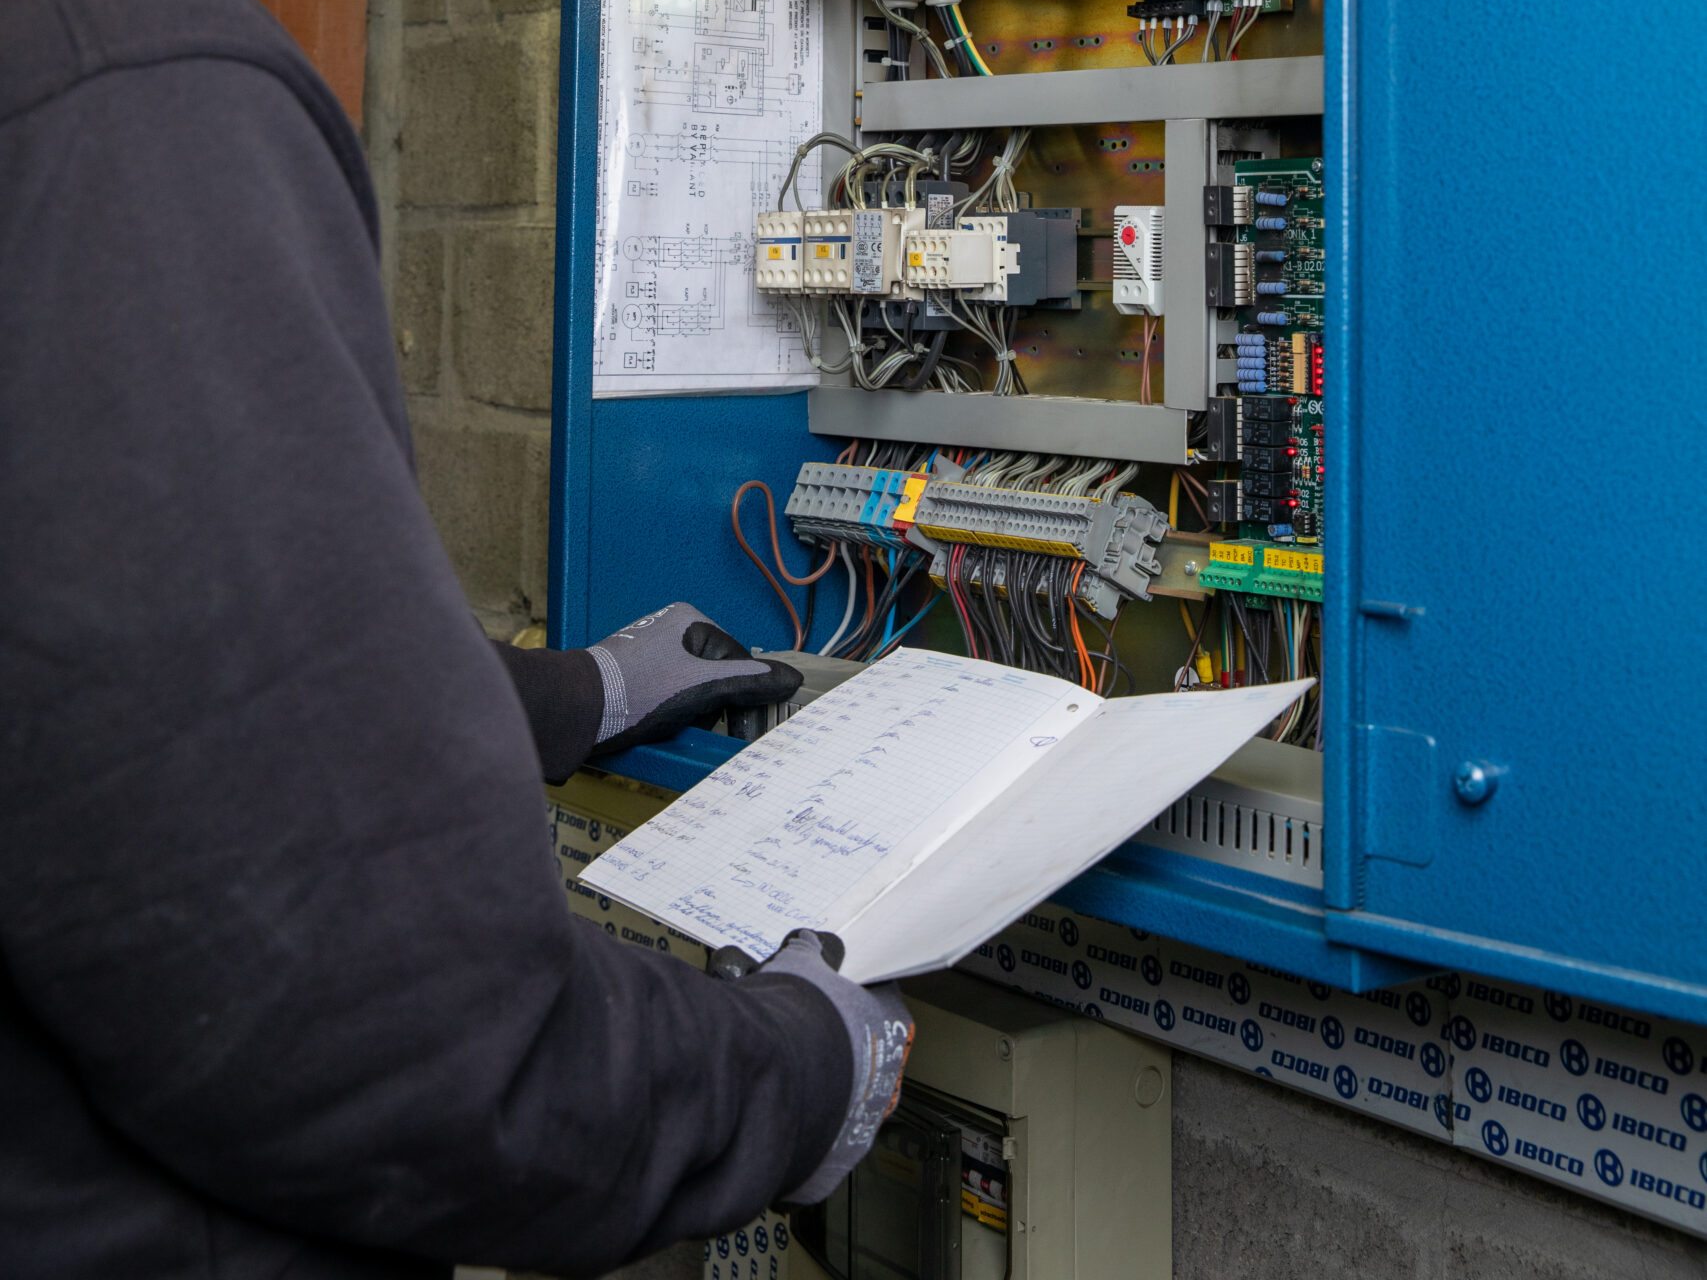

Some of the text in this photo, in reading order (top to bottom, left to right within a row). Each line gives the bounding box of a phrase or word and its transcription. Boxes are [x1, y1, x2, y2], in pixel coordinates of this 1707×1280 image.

[690, 125, 698, 139] BY
[1021, 949, 1068, 976] IBOCO
[1087, 944, 1138, 971] IBOCO
[1170, 960, 1224, 989] IBOCO
[1100, 988, 1150, 1016] IBOCO
[1466, 980, 1535, 1015] IBOCO
[1183, 1005, 1237, 1036] IBOCO
[1259, 1002, 1316, 1033] IBOCO
[1578, 1004, 1652, 1040] IBOCO
[1354, 1026, 1416, 1060] IBOCO
[1481, 1032, 1550, 1068] IBOCO
[1271, 1049, 1330, 1082] IBOCO
[1594, 1057, 1669, 1095] IBOCO
[1368, 1076, 1429, 1112] IBOCO
[1498, 1085, 1567, 1122] IBOCO
[1612, 1112, 1687, 1152] IBOCO
[1514, 1138, 1584, 1177] IBOCO
[1630, 1168, 1706, 1210] IBOCO
